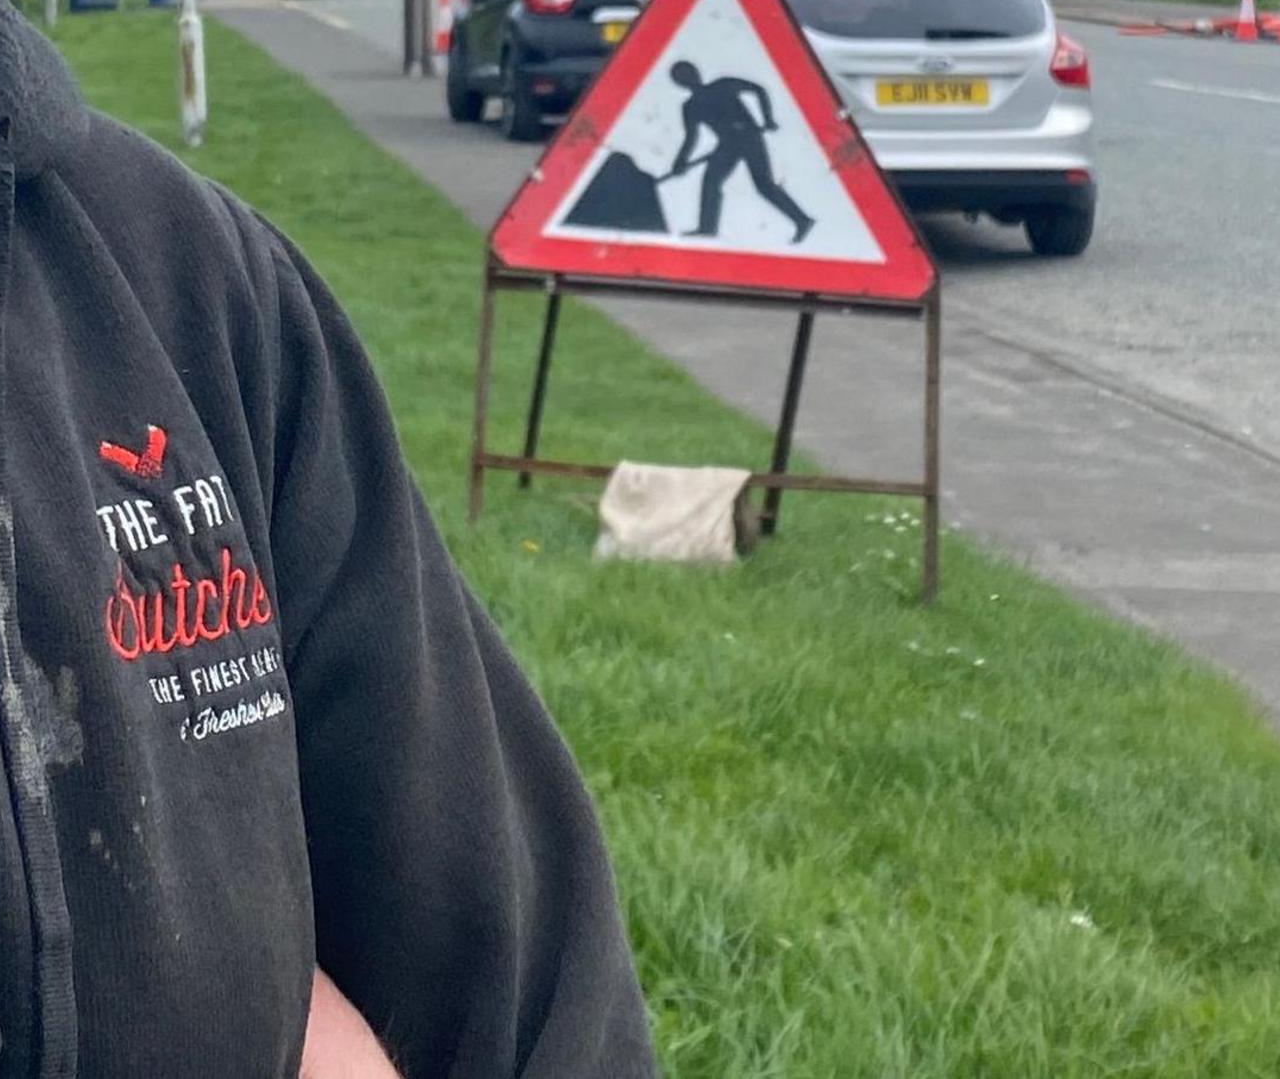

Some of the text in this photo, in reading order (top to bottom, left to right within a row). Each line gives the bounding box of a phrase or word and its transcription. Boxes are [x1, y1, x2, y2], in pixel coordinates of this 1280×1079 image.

[96, 475, 235, 552] THE FAT
[148, 675, 185, 704] THE
[190, 657, 250, 696] FINEST
